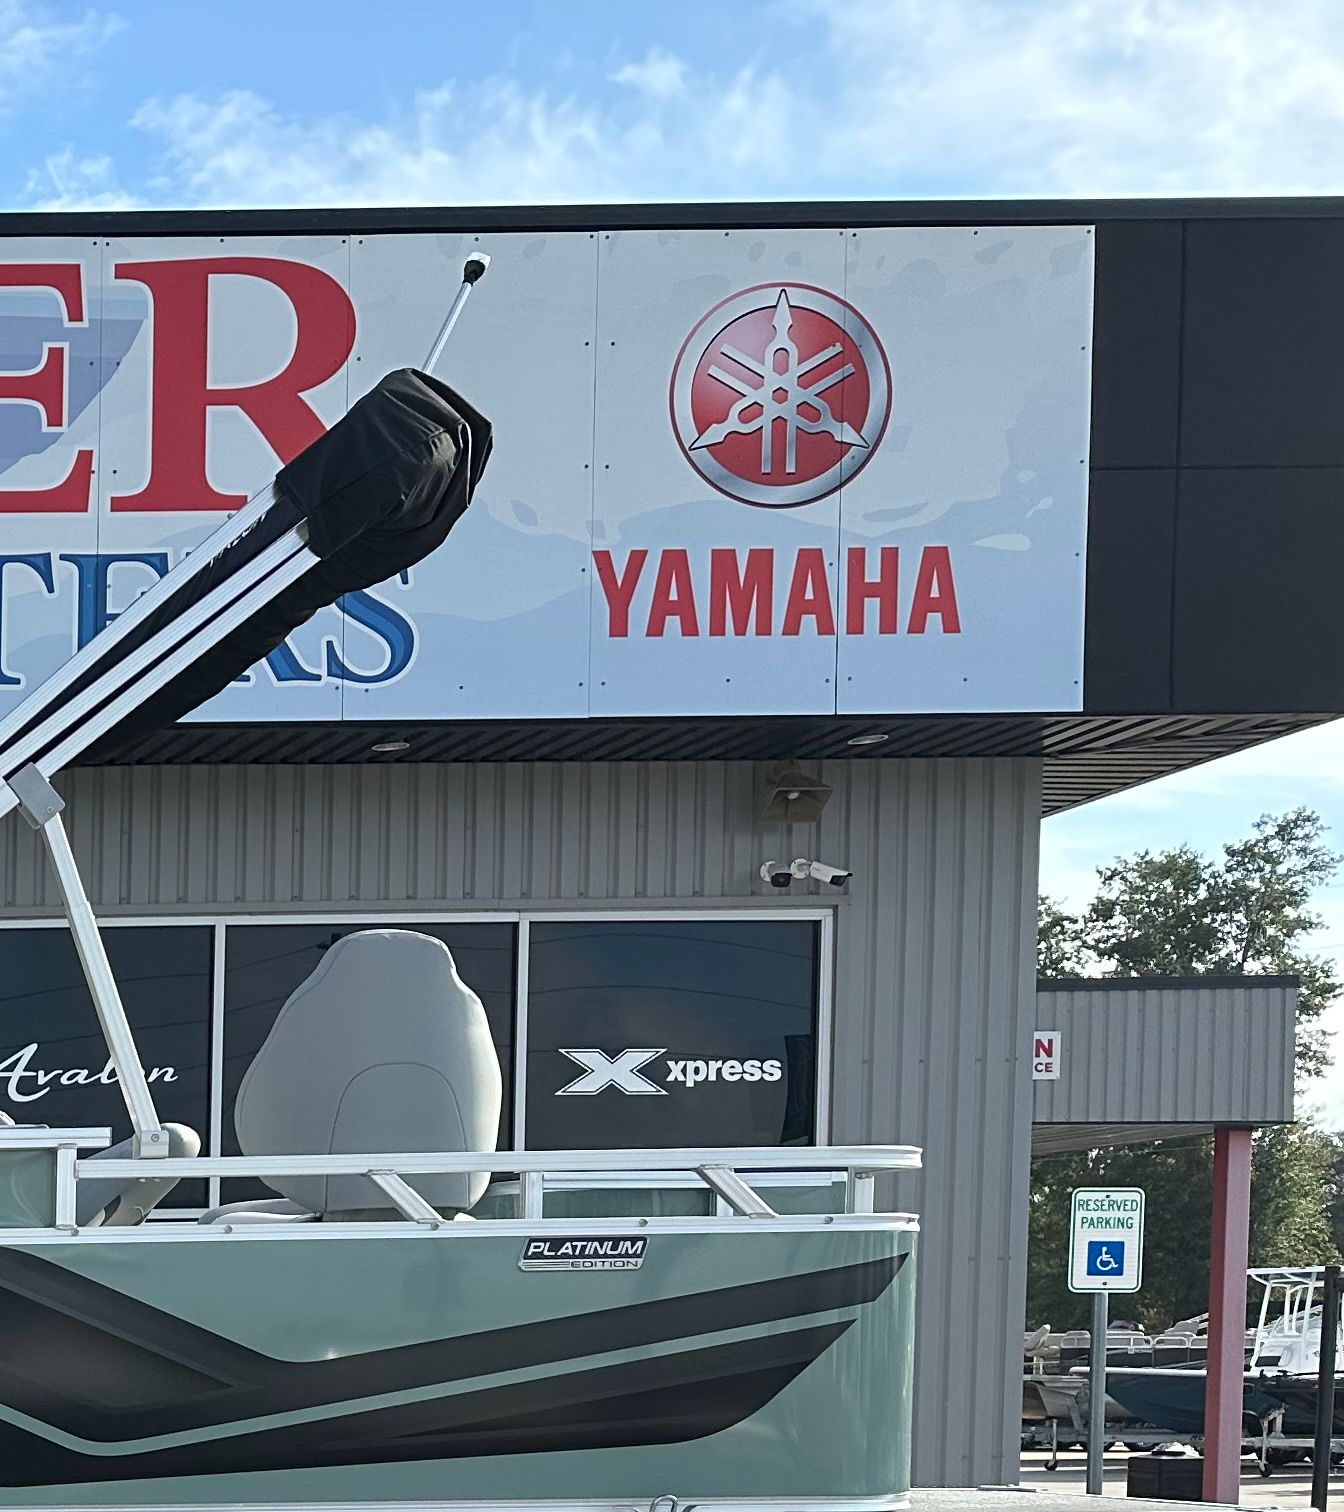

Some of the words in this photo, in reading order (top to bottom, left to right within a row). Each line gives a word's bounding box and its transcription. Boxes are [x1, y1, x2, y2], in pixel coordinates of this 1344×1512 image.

[591, 546, 962, 639] YAMAHA
[665, 1059, 783, 1088] xpress
[1077, 1198, 1139, 1212] RESERVED
[1080, 1216, 1134, 1230] PARKING
[527, 1240, 645, 1257] PLATINUM
[570, 1260, 639, 1268] EDITION
